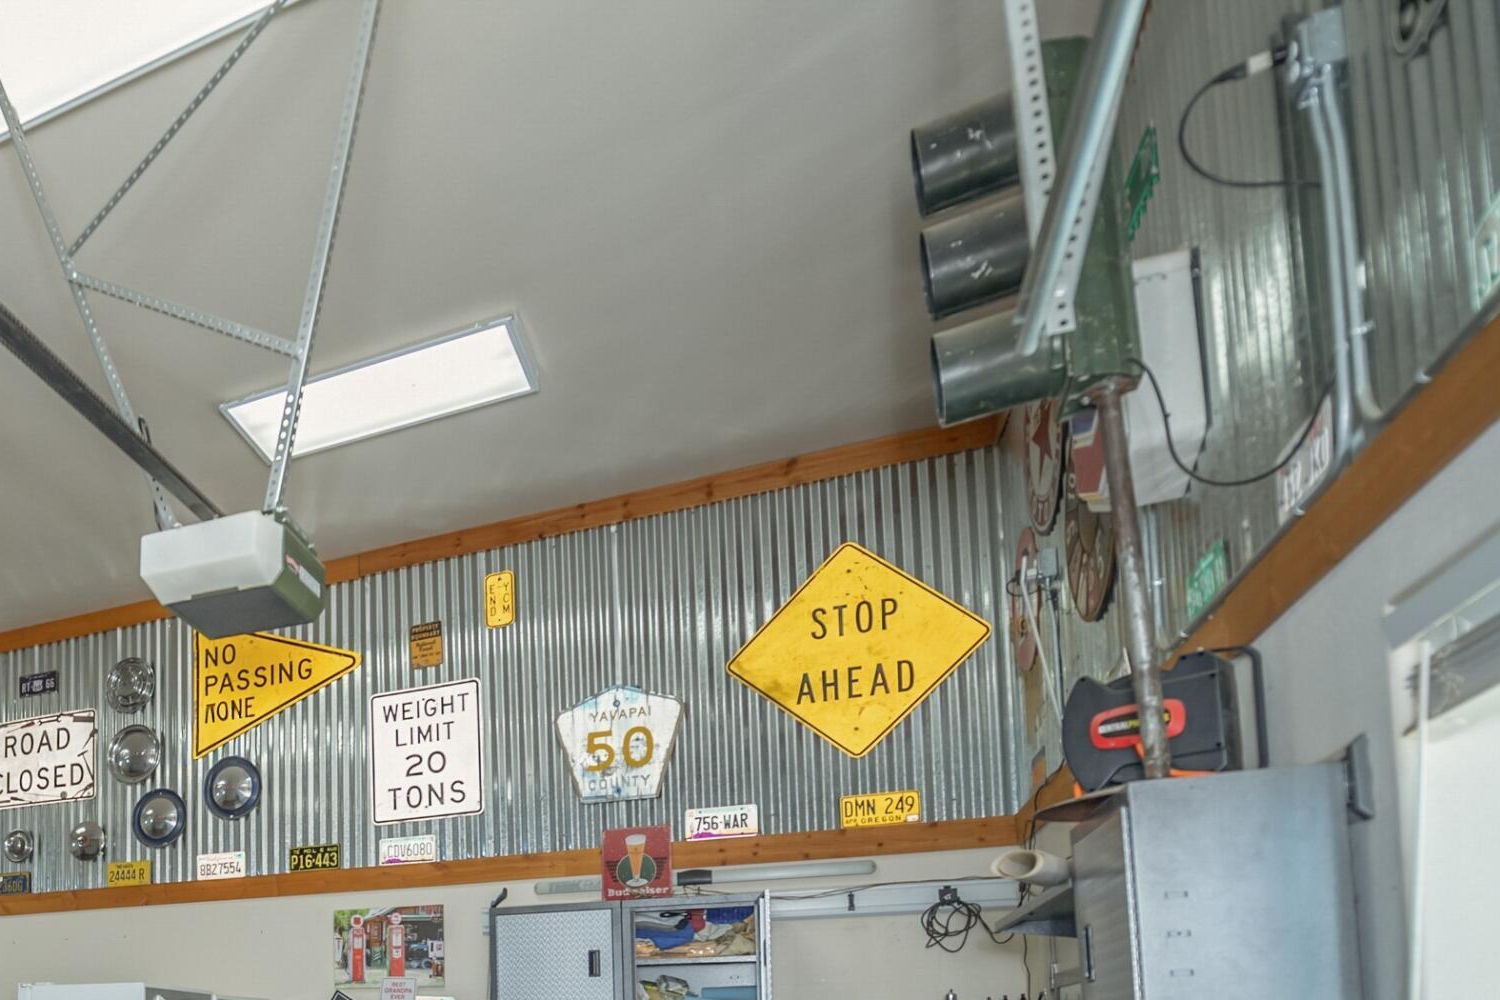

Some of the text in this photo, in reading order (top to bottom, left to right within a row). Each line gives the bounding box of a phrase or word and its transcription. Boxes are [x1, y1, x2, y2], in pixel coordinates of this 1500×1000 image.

[811, 598, 898, 640] STOP
[205, 643, 236, 669] NO
[205, 658, 313, 697] PASSING
[796, 660, 915, 705] AHEAD
[383, 692, 470, 724] WEIGHT
[589, 705, 652, 723] YAVAPAI
[4, 727, 71, 758] ROAD
[395, 721, 455, 748] LIMIT
[585, 726, 655, 772] 50
[405, 750, 447, 778] 20
[388, 780, 466, 810] TONS
[844, 795, 915, 818] DMN 249
[860, 814, 902, 825] OREGON
[607, 886, 670, 897] Budiser
